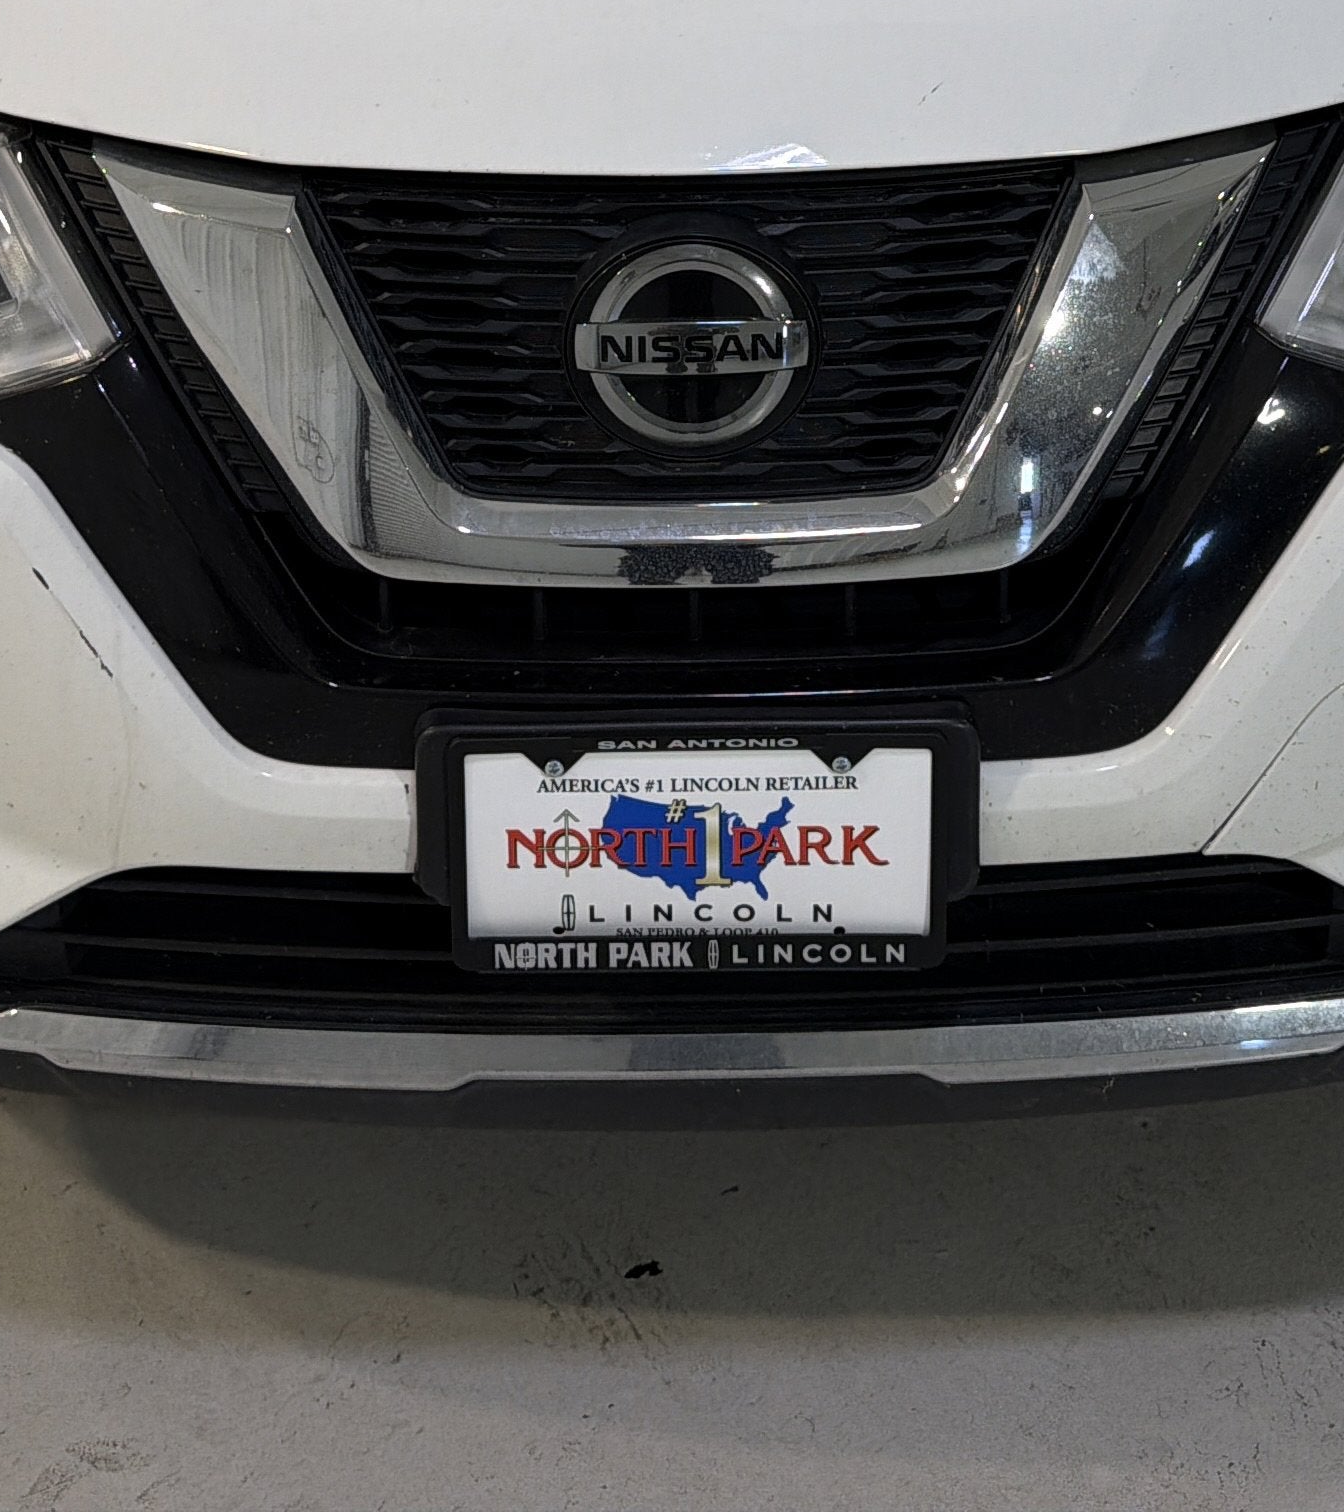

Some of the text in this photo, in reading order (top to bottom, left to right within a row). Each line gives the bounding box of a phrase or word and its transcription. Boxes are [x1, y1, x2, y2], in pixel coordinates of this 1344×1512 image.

[600, 332, 784, 364] NISSAN
[597, 738, 799, 750] SAN ANTONIO
[537, 775, 858, 794] AMERICA'S #1 LINCOLN RETAILER
[505, 825, 890, 869] NORTH PARK
[589, 902, 834, 924] LINCOLN
[616, 927, 644, 938] SAN
[647, 927, 696, 938] PEDRO
[713, 927, 753, 937] LOOP
[494, 941, 907, 969] NORTH PARK LINCOLN
